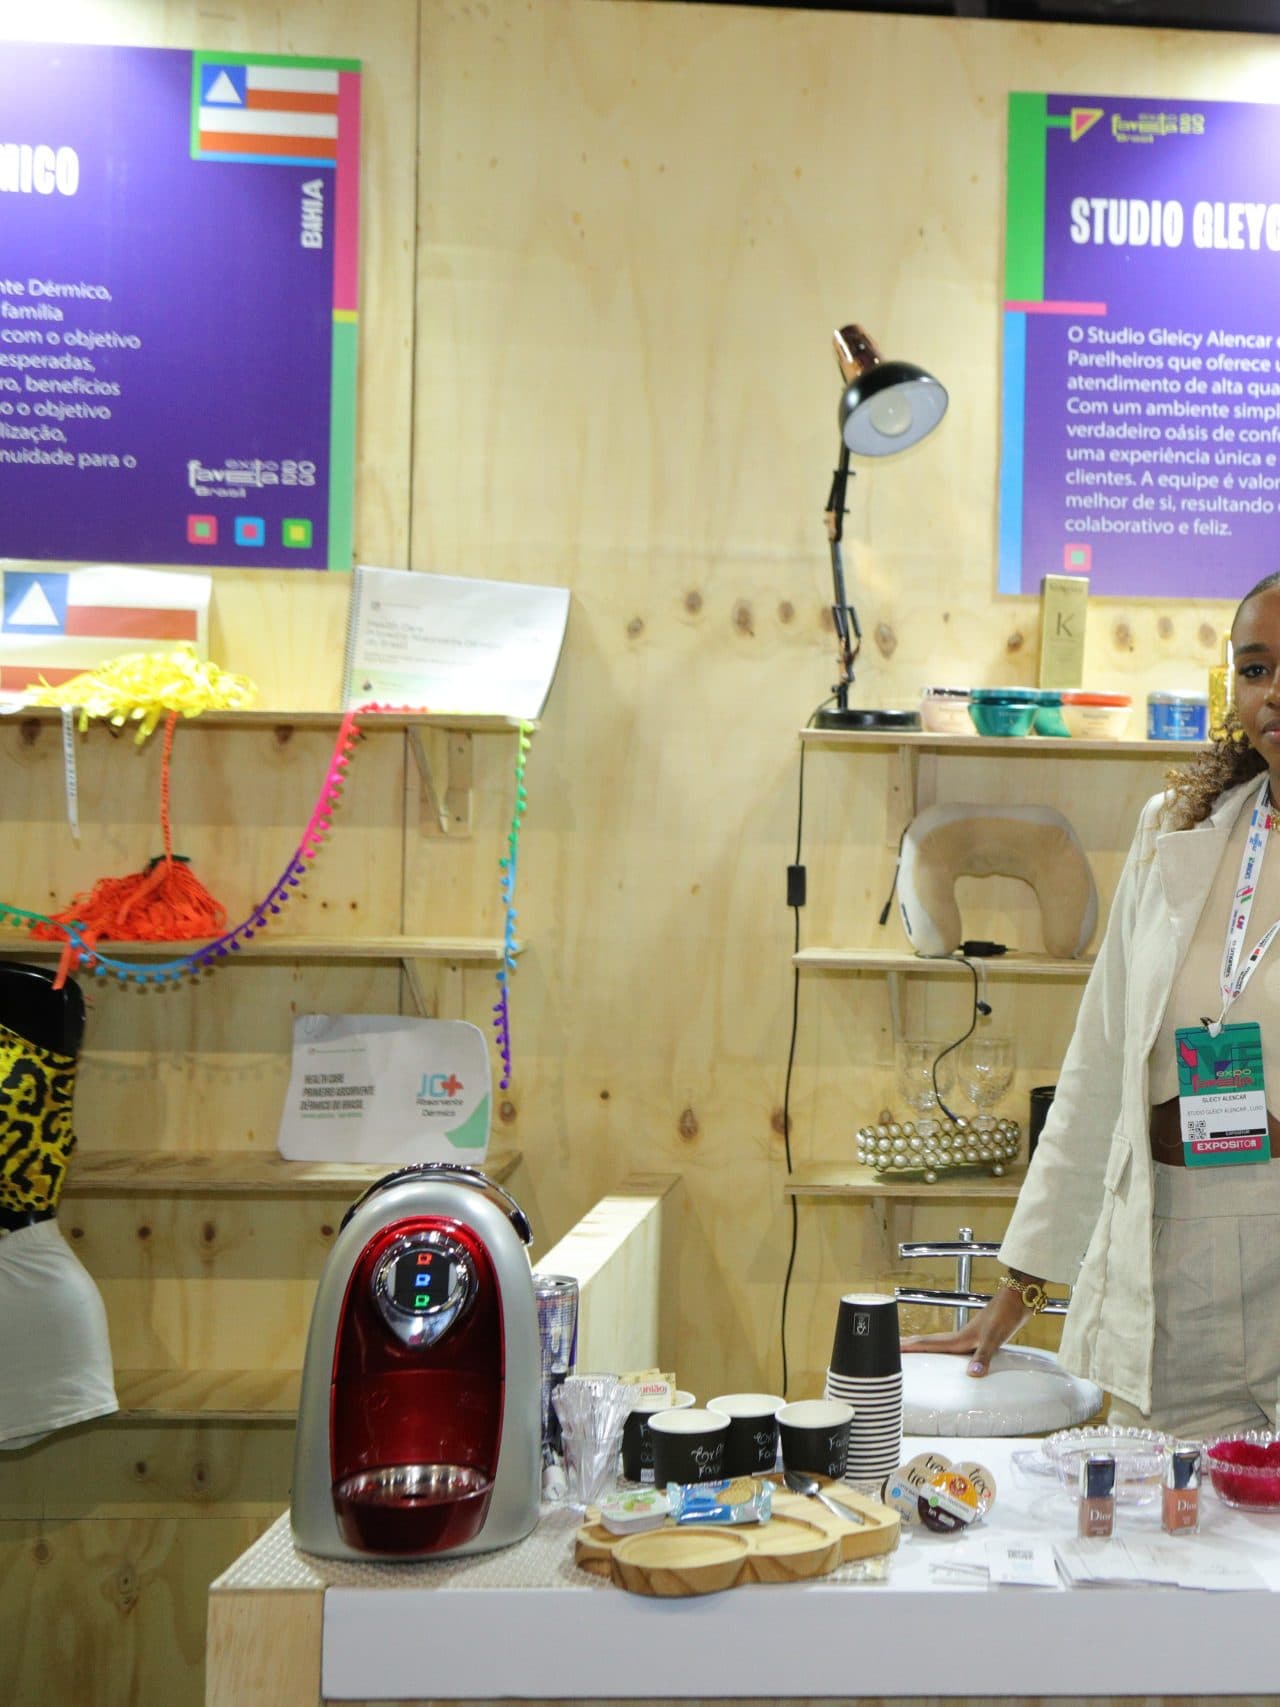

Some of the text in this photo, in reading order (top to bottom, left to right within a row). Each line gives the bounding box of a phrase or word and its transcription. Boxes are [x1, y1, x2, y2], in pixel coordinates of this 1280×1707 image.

[302, 179, 323, 248] BAHIA
[1071, 197, 1182, 247] STUDIO
[29, 280, 111, 303] Dérmico,
[1, 301, 62, 320] família
[1, 328, 140, 353] com o objetivo
[1068, 325, 1083, 344] O
[1088, 326, 1144, 345] Studio
[1149, 328, 1202, 351] Gleicy
[1206, 329, 1272, 349] Alencar
[1068, 349, 1163, 370] Parelheiros
[1168, 357, 1202, 375] que
[1206, 353, 1270, 373] oferece
[26, 375, 119, 395] benefícios
[1067, 372, 1180, 394] atendimento
[1185, 376, 1207, 395] de
[1212, 377, 1242, 396] alta
[16, 402, 29, 415] o
[34, 400, 110, 420] objetivo
[1067, 396, 1107, 415] Com
[1113, 402, 1141, 416] um
[1146, 398, 1229, 418] ambiente
[1067, 420, 1162, 440] verdadeiro
[1165, 422, 1207, 441] oásis
[1212, 424, 1234, 442] de
[79, 453, 118, 468] para
[123, 455, 135, 467] o
[1067, 448, 1104, 462] uma
[1110, 444, 1209, 469] experiência
[1215, 447, 1261, 466] única
[1266, 454, 1276, 467] e
[1066, 467, 1135, 487] clientes.
[1141, 469, 1153, 487] A
[1158, 469, 1220, 493] equipe
[1223, 471, 1233, 489] é
[1066, 489, 1127, 509] melhor
[1133, 491, 1154, 510] de
[1160, 492, 1175, 513] si,
[1181, 493, 1273, 514] resultando
[1065, 514, 1231, 536] colaborativo e feliz.
[1055, 611, 1073, 638] K
[1216, 1069, 1252, 1077] expo
[1090, 1509, 1112, 1521] Dior
[1177, 1499, 1197, 1512] Dior
